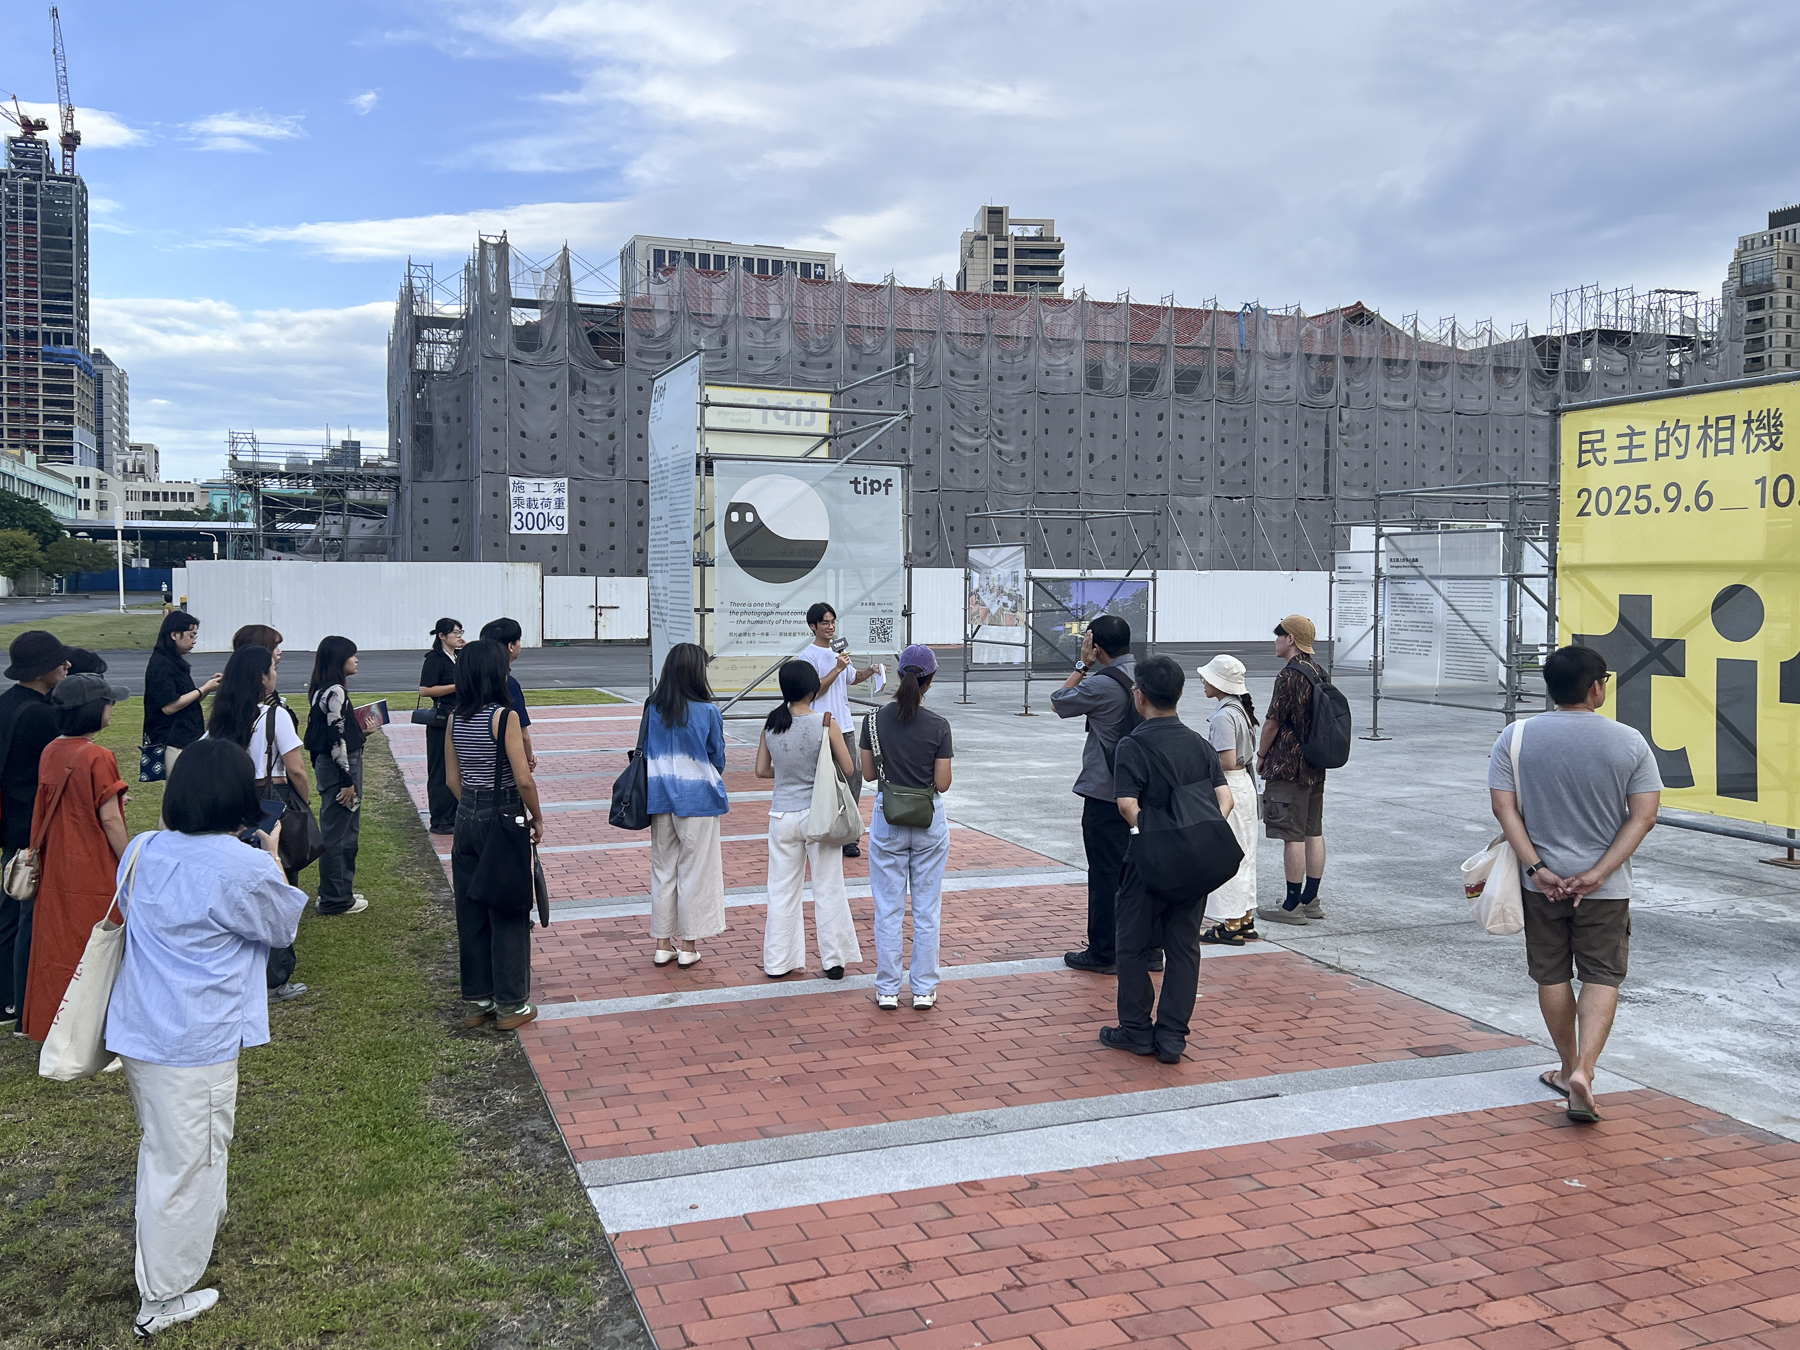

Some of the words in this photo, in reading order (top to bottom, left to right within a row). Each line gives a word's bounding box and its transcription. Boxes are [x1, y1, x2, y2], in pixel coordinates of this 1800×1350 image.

[653, 381, 667, 404] tipf
[1577, 407, 1784, 469] 民主的相機
[511, 480, 566, 494] 施工架
[849, 476, 894, 496] tipf
[513, 511, 565, 531] 300kg
[740, 610, 775, 618] photograph
[764, 601, 780, 609] thing
